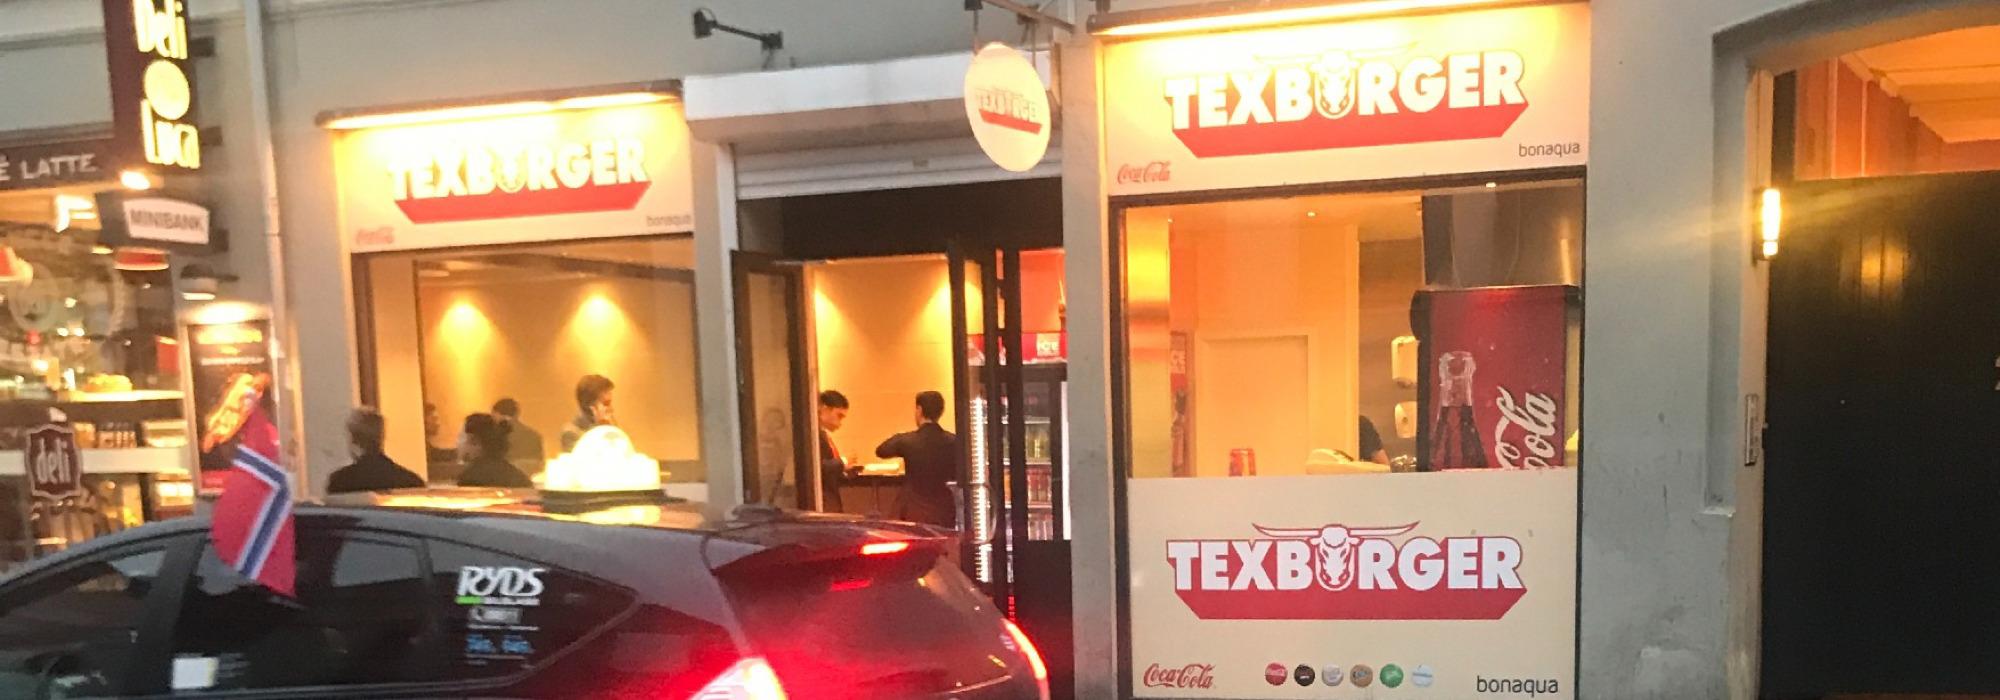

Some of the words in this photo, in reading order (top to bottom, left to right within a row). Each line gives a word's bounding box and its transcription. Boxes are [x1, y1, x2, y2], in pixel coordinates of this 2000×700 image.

[1165, 50, 1528, 130] TEXBURGER
[1519, 141, 1581, 159] bonaqua
[20, 153, 99, 180] LATTE
[386, 138, 650, 200] TEXBURGER
[130, 208, 204, 231] MINIBANK
[36, 437, 71, 485] deli
[1166, 536, 1527, 592] TEXBURGER
[457, 566, 545, 597] RYDS
[1476, 675, 1559, 698] bonaqua
